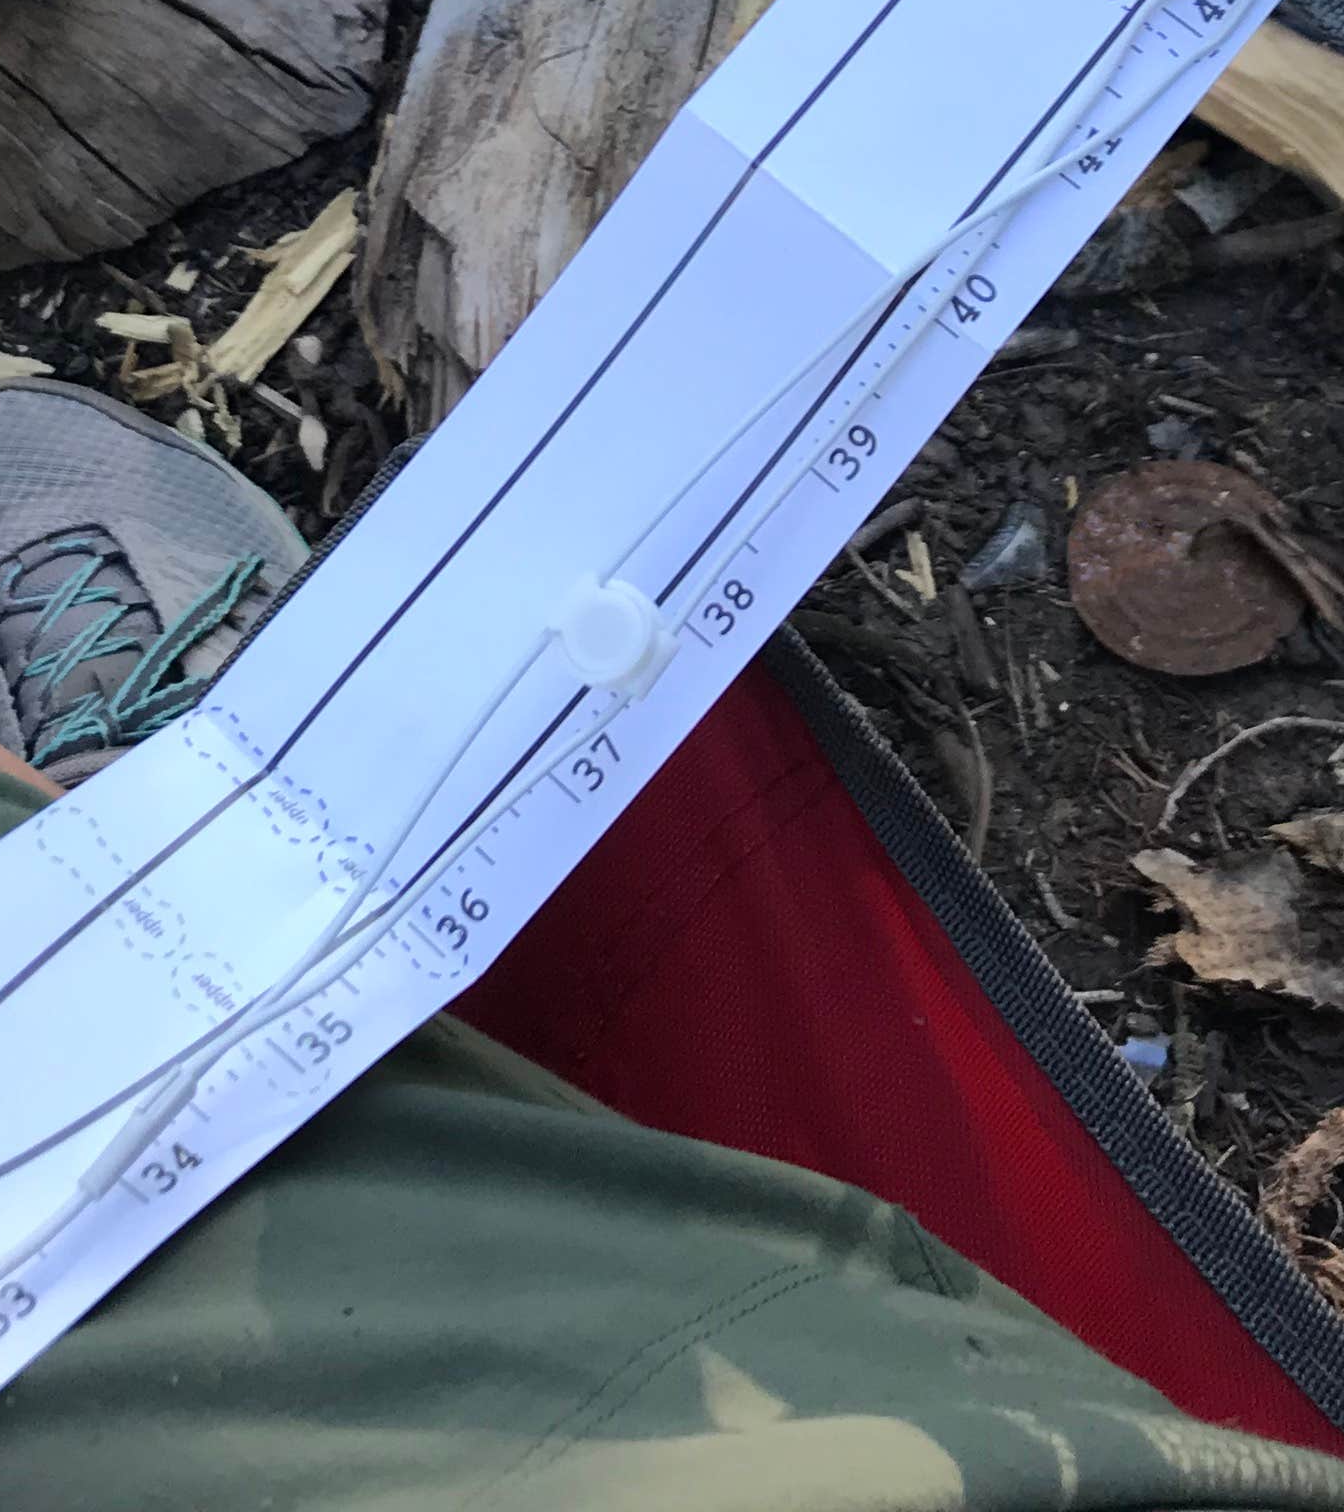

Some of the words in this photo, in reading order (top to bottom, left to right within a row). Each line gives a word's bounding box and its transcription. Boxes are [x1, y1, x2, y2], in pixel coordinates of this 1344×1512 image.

[948, 274, 997, 327] 40
[829, 425, 878, 484] 39
[703, 579, 754, 637] 38
[572, 734, 622, 792] 37
[268, 790, 309, 824] upper
[337, 856, 368, 881] per
[123, 899, 164, 938] upper
[436, 889, 490, 950] 36
[193, 974, 236, 1010] upper
[296, 1014, 353, 1065] 35
[141, 1141, 202, 1194] 34
